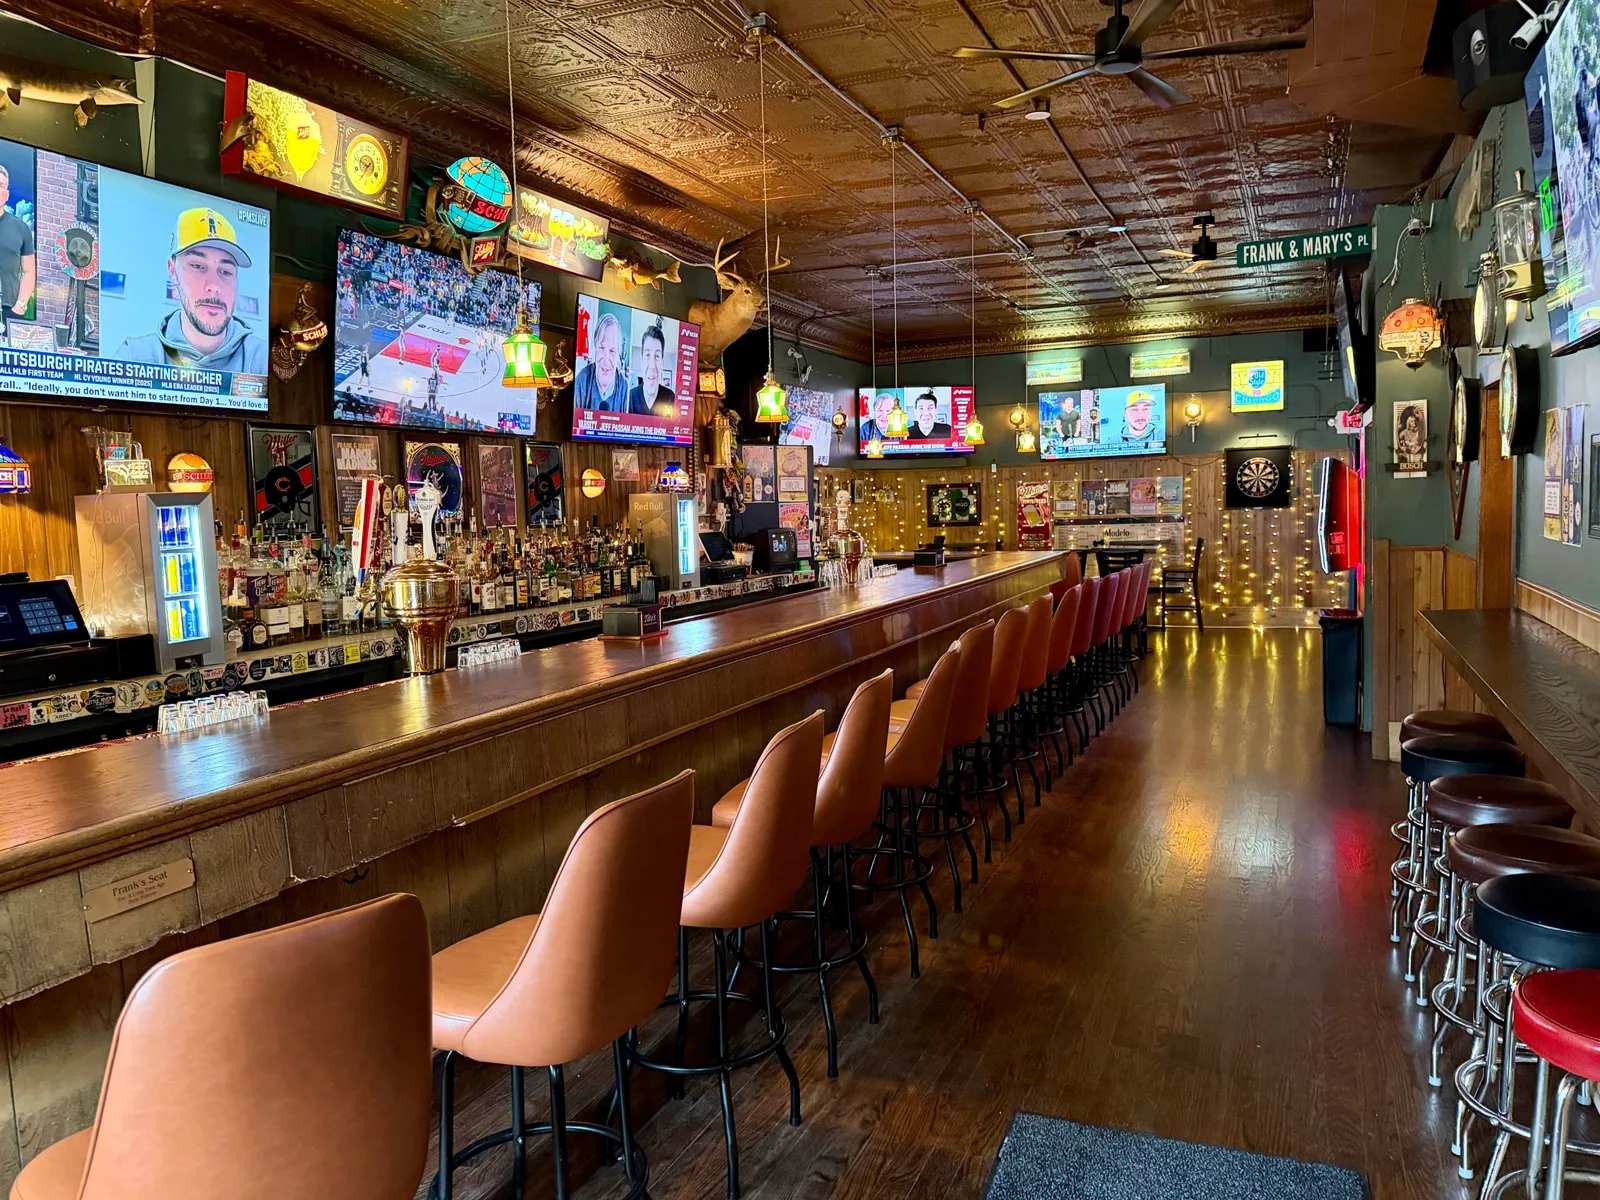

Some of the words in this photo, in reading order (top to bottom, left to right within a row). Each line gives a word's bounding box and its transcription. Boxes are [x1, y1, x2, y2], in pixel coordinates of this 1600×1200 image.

[1243, 240, 1284, 264] FRANK
[1289, 239, 1299, 259] &
[1303, 232, 1353, 257] MARY'S
[1357, 235, 1369, 247] PL
[13, 368, 27, 376] MLB
[28, 369, 46, 378] FIRST
[47, 371, 64, 379] TEAM
[75, 358, 123, 376] PIRATES
[125, 363, 178, 382] STARTING
[180, 369, 222, 386] PITCHER
[1255, 371, 1265, 379] Old
[91, 375, 111, 384] YOUNG
[112, 377, 134, 386] WINNER
[161, 381, 173, 389] MLB
[185, 384, 203, 392] LEADER
[238, 381, 263, 393] ESPN
[65, 386, 81, 395] you
[83, 386, 106, 396] don't
[107, 389, 129, 398] want
[131, 389, 147, 399] him
[149, 392, 157, 401] to
[159, 392, 178, 402] start
[180, 394, 198, 404] from
[200, 396, 213, 406] Day
[228, 399, 247, 408] You'd
[249, 400, 262, 409] love
[262, 433, 298, 452] Miller
[341, 447, 372, 460] MARCH
[337, 458, 377, 471] MADNESS
[1399, 462, 1424, 470] BUSCH
[634, 501, 649, 511] Red
[649, 501, 664, 511] Bull
[105, 507, 126, 524] Bull
[1104, 528, 1130, 538] Modelo
[112, 879, 147, 897] Frank's
[148, 871, 168, 884] Seat
